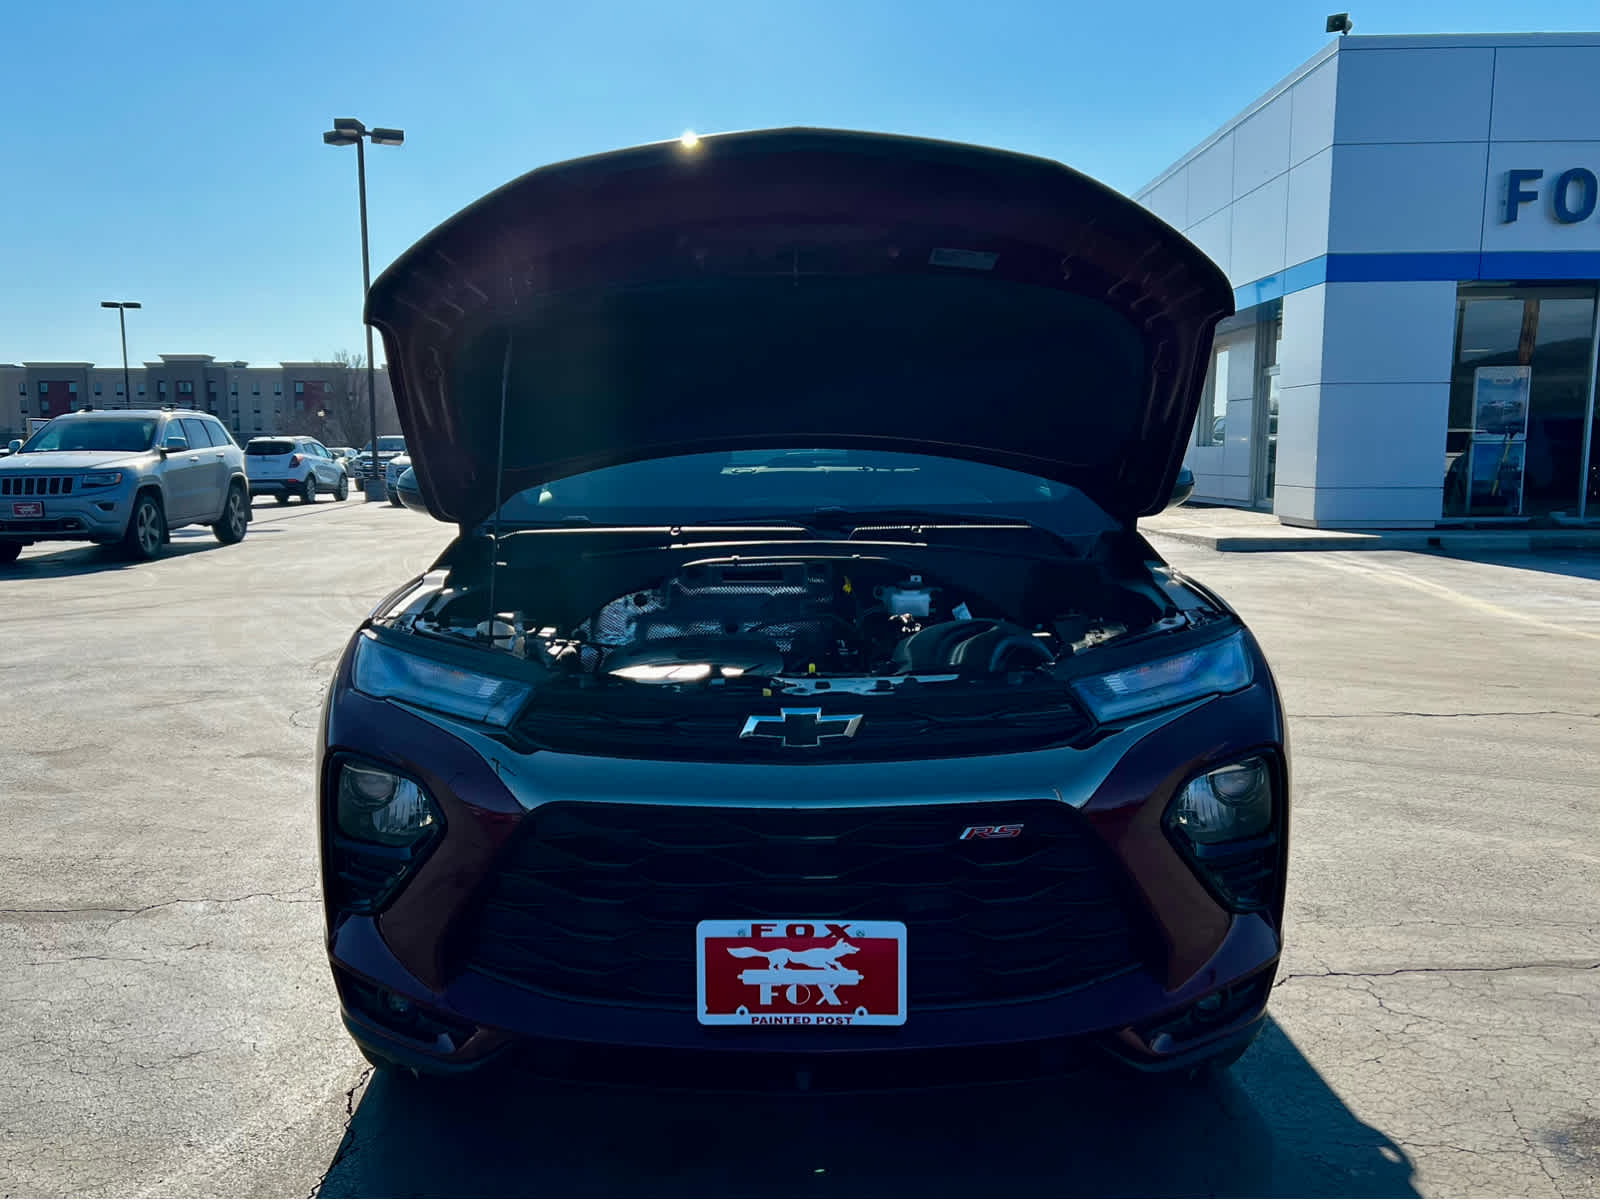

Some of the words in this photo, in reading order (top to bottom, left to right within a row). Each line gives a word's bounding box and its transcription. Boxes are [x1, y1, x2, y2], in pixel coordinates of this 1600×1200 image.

[1504, 168, 1598, 224] FO
[960, 824, 1024, 840] RS
[751, 923, 852, 938] FOX
[760, 983, 842, 1006] FOX
[751, 1016, 811, 1025] PAINTED
[816, 1016, 853, 1025] POST
